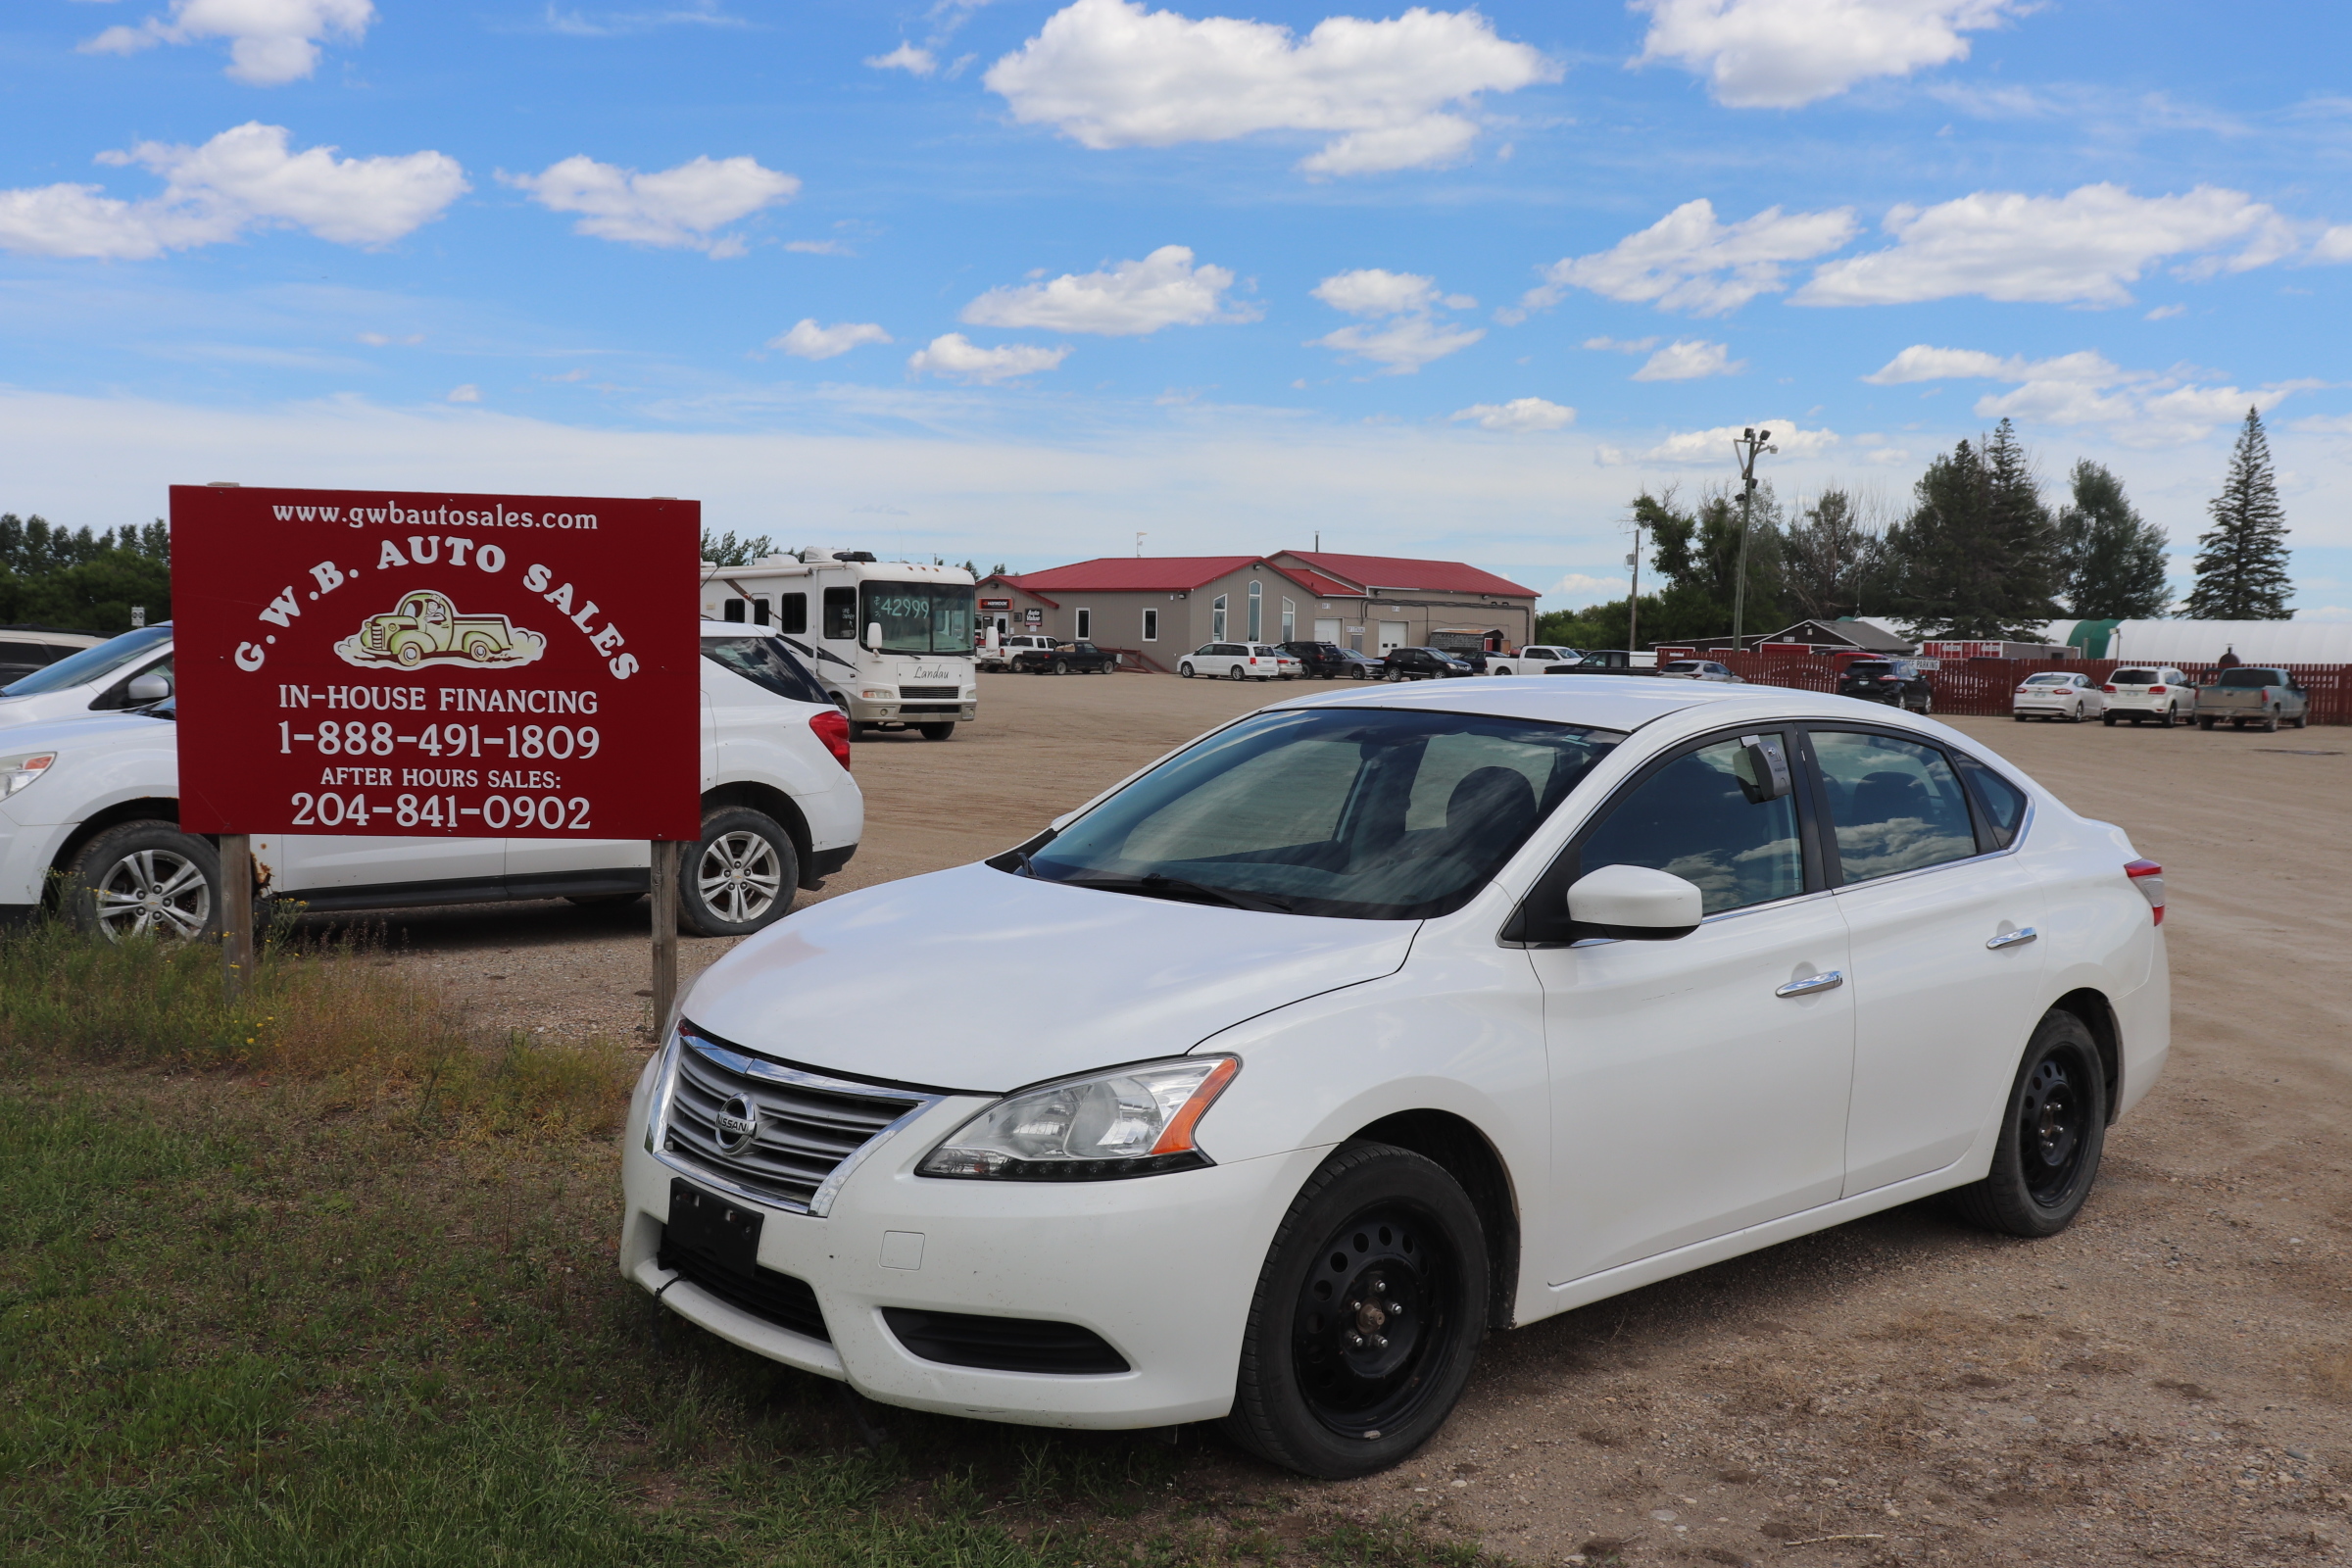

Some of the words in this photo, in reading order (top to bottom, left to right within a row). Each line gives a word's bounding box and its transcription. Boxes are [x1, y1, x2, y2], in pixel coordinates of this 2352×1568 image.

[271, 500, 598, 530] www.gwbautosales.com
[234, 562, 359, 672] G.W.B.
[376, 535, 506, 573] AUTO
[522, 564, 640, 680] SALES
[913, 664, 950, 679] Landau
[1916, 660, 1938, 670] PARKING
[278, 684, 426, 710] IN-HOUSE
[439, 687, 598, 714] FINANCING
[278, 720, 600, 760] 1-888-491-1809
[319, 766, 394, 787] AFTER
[402, 768, 478, 788] HOURS
[487, 769, 563, 789] SALES:
[291, 792, 591, 831] 204-841-0902
[716, 1116, 747, 1132] NISSAN
